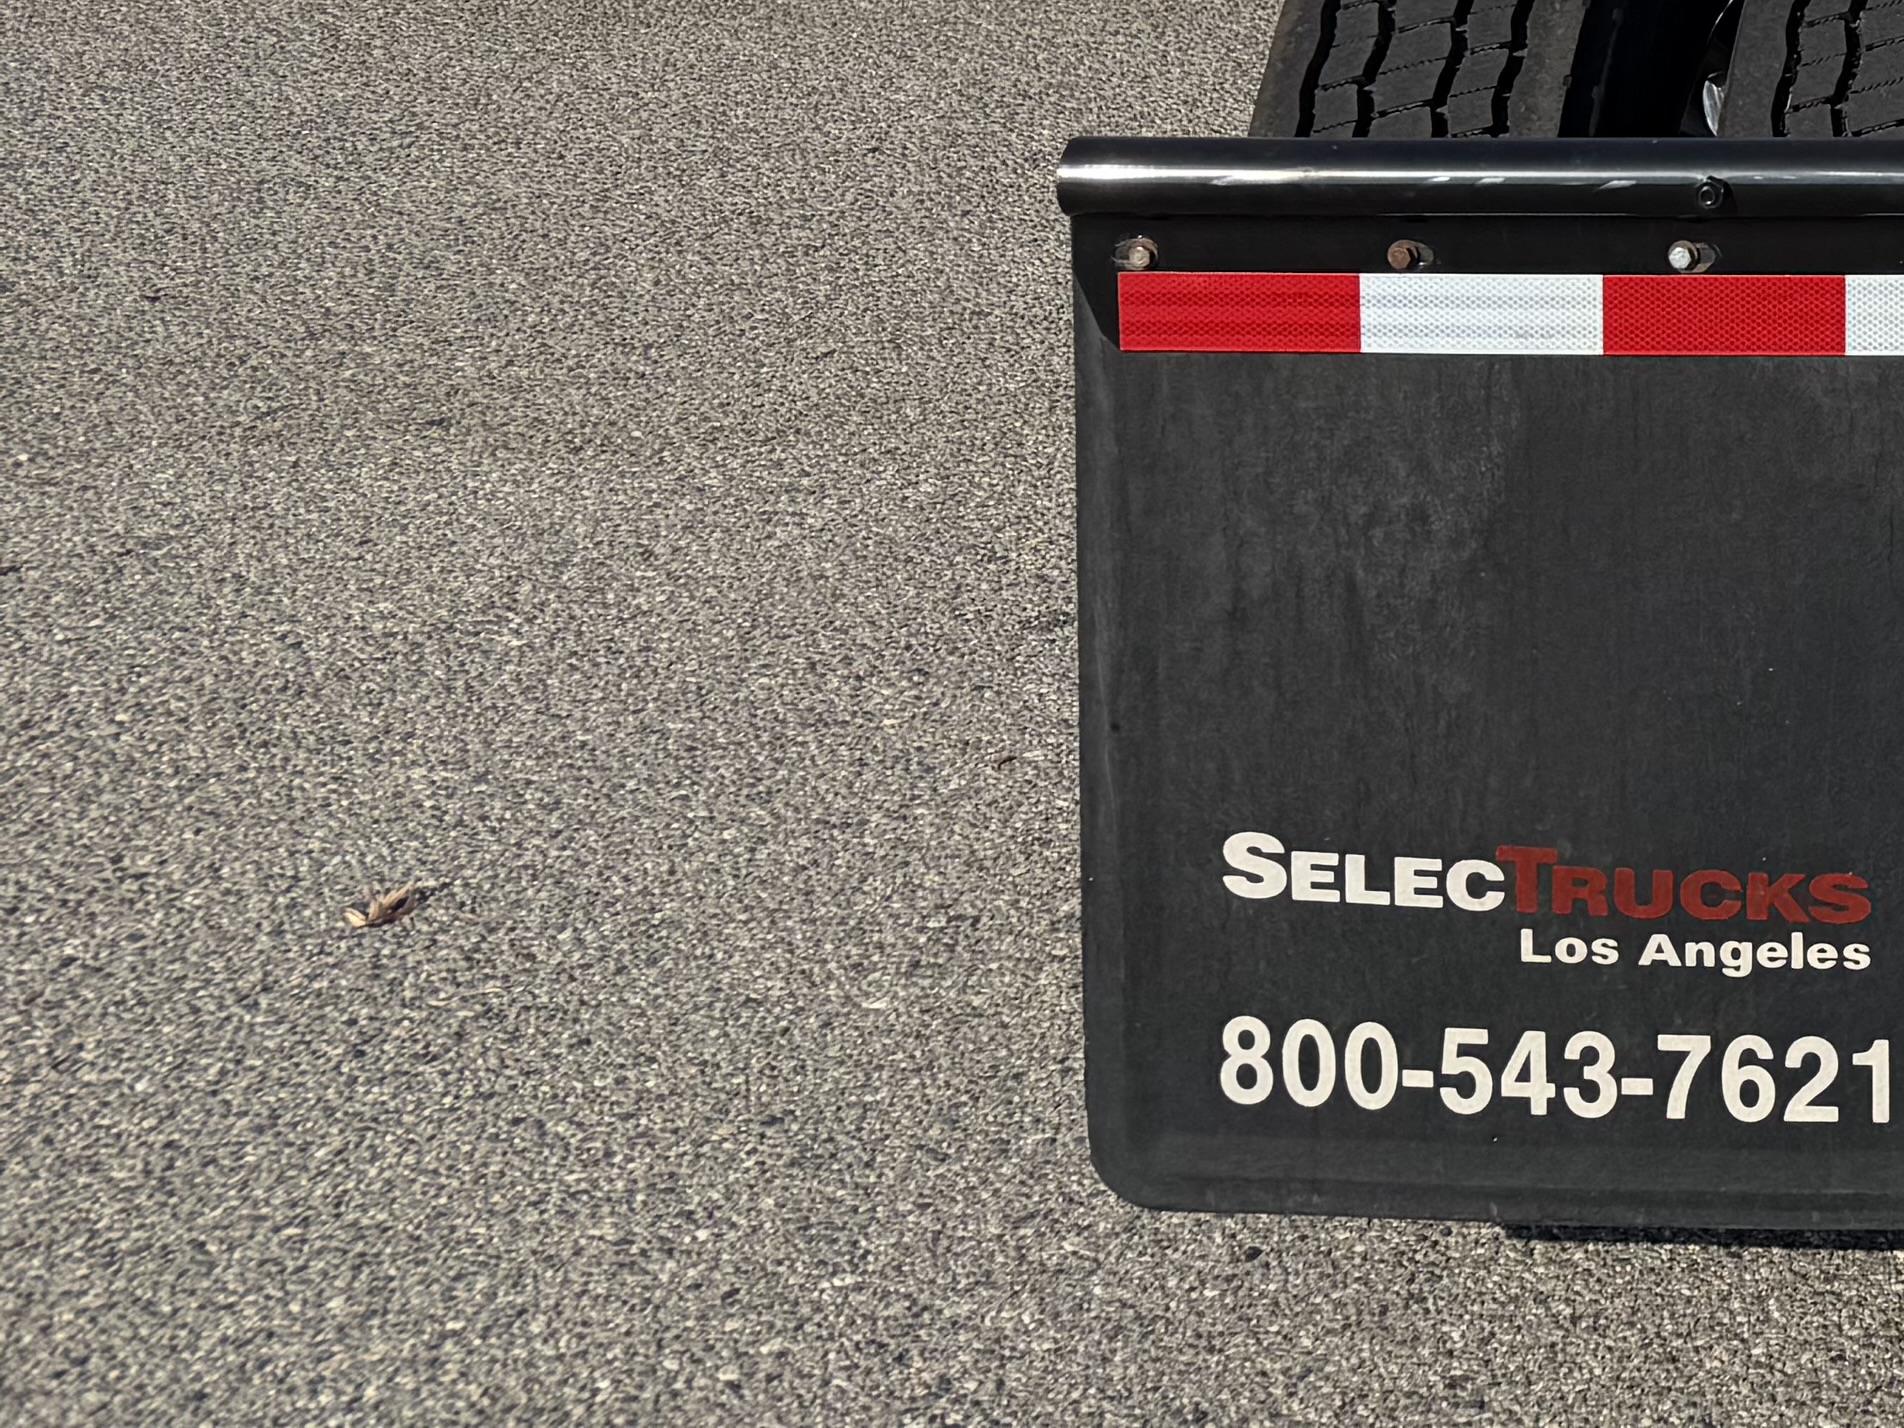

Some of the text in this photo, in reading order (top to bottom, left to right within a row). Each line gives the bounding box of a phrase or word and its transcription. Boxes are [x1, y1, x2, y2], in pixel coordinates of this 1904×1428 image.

[1520, 928, 1871, 978] Los Angeles
[1219, 1015, 1890, 1124] 800-543-7621
